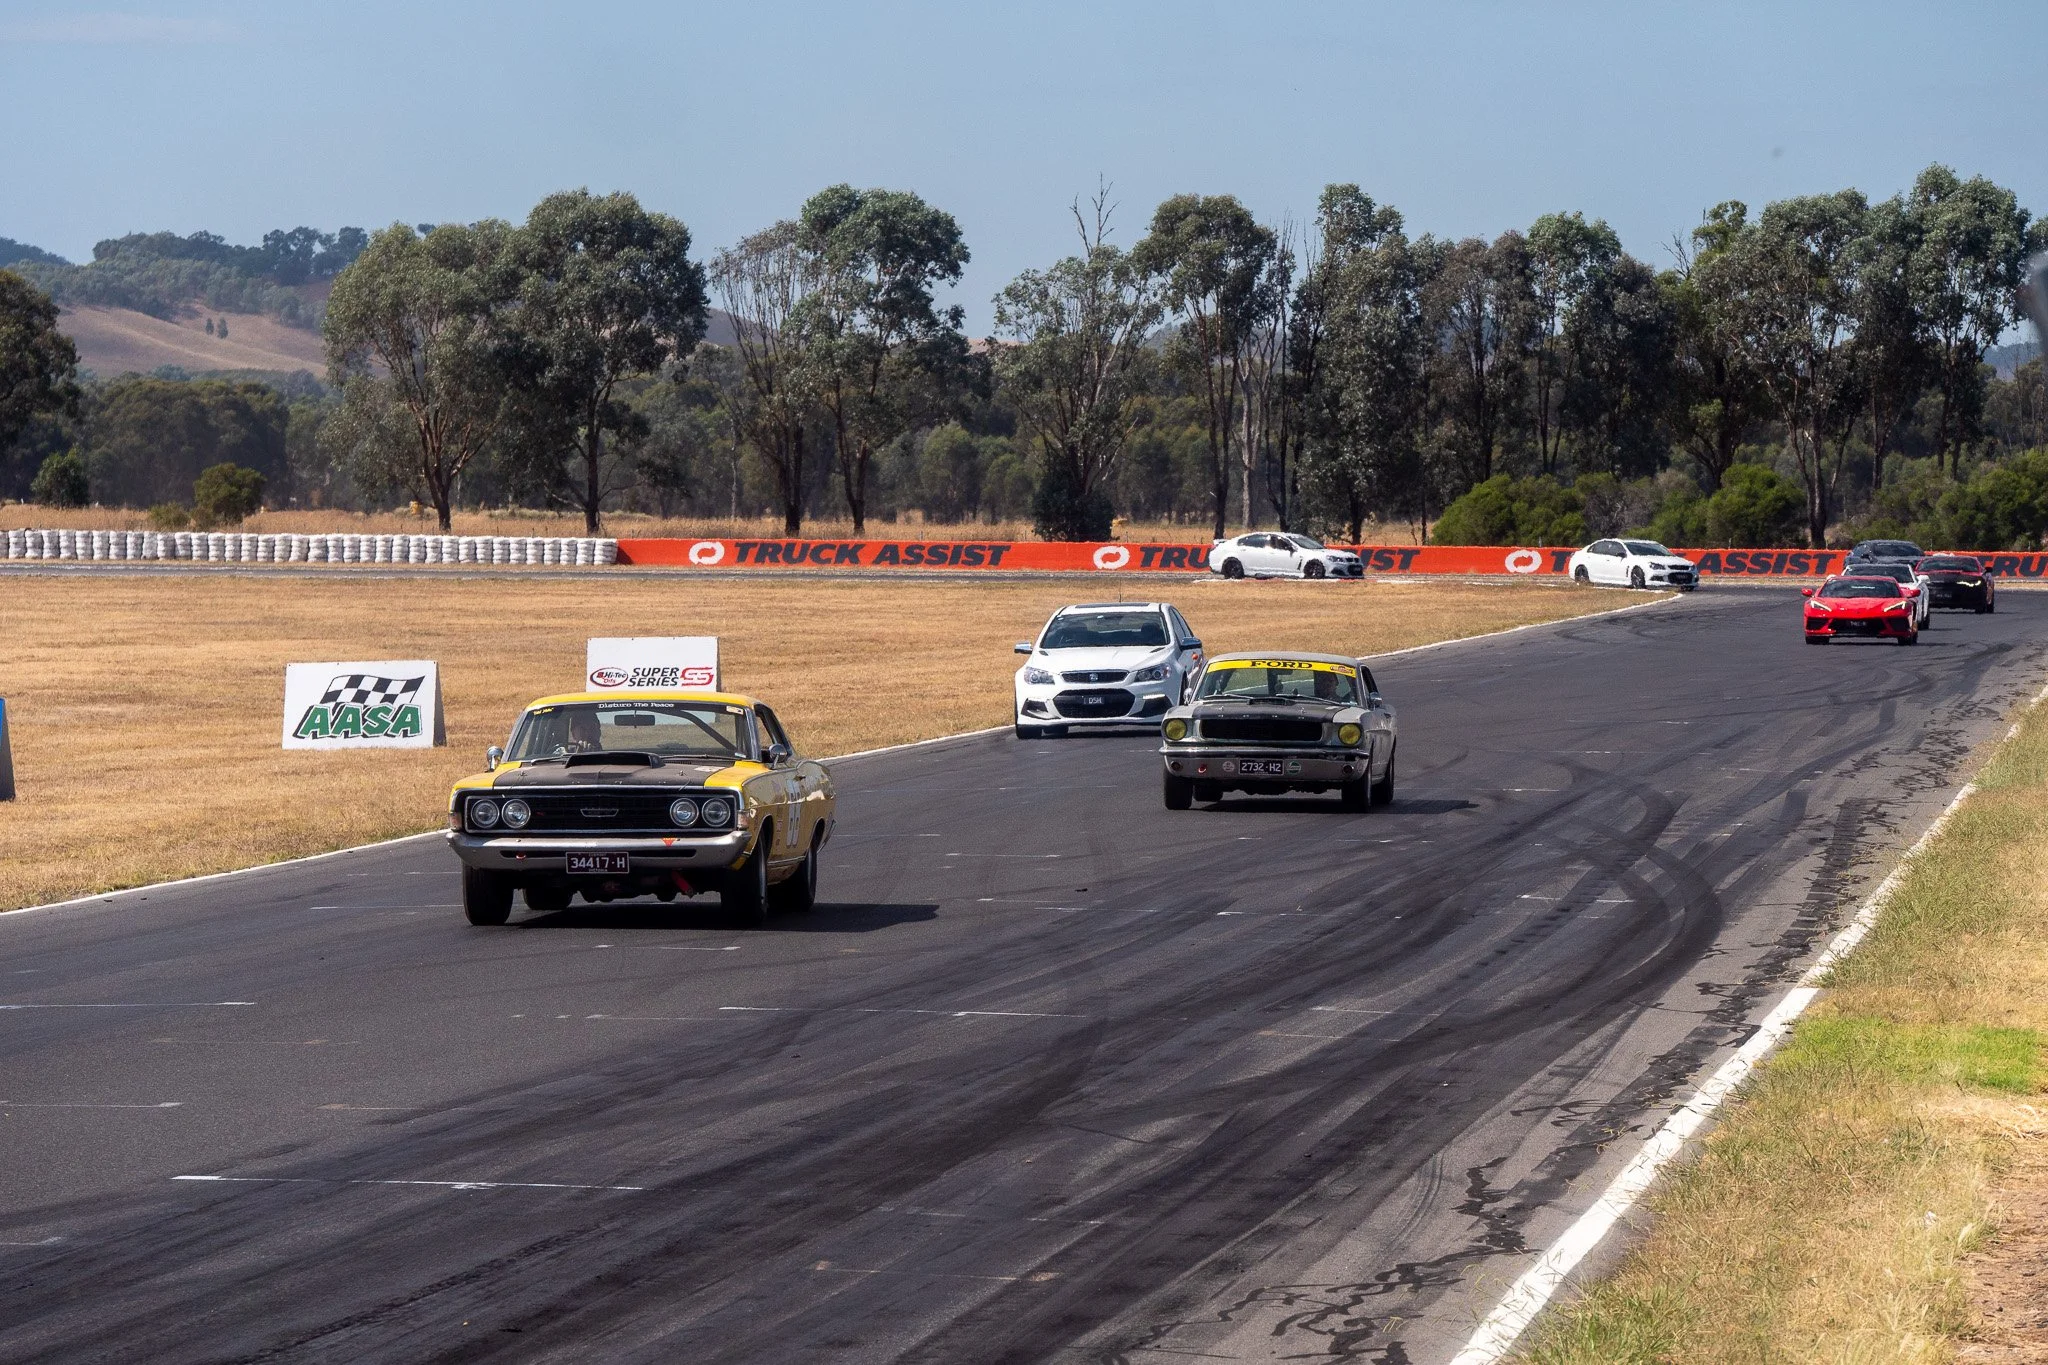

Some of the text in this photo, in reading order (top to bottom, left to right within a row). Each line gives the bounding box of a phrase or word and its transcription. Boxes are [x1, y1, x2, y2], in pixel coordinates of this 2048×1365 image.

[734, 542, 1012, 567] TRUCK ASSIST
[1140, 546, 1421, 571] TRU IST
[1697, 552, 1838, 575] ASSIST
[1977, 555, 2048, 577] TRU
[632, 667, 680, 678] SUPER
[1250, 660, 1312, 669] FORD
[628, 677, 679, 687] SERIES
[293, 703, 422, 739] AASA
